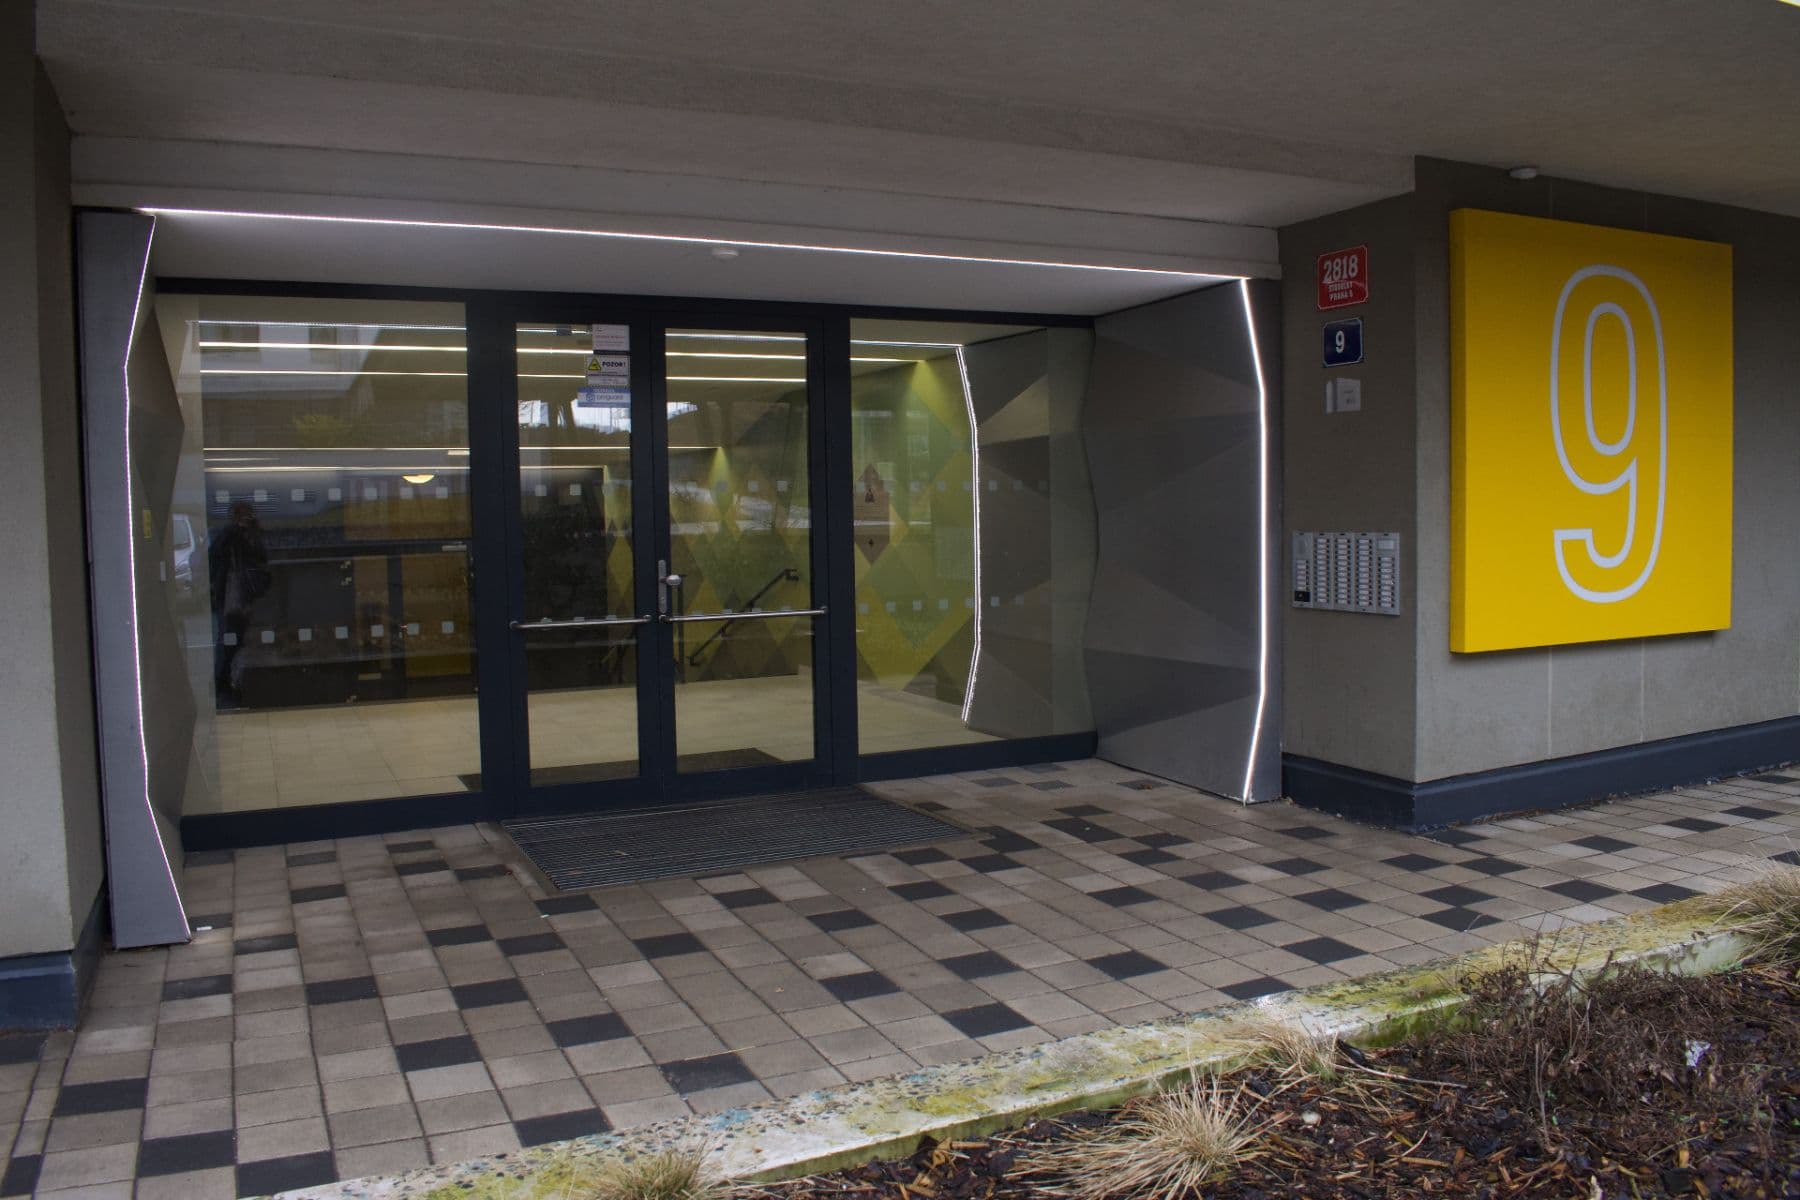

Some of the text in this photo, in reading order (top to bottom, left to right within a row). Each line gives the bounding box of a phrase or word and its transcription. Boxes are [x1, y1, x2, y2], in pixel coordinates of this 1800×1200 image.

[1322, 254, 1358, 284] 2818
[1335, 330, 1345, 354] 9
[1550, 264, 1667, 604] 9
